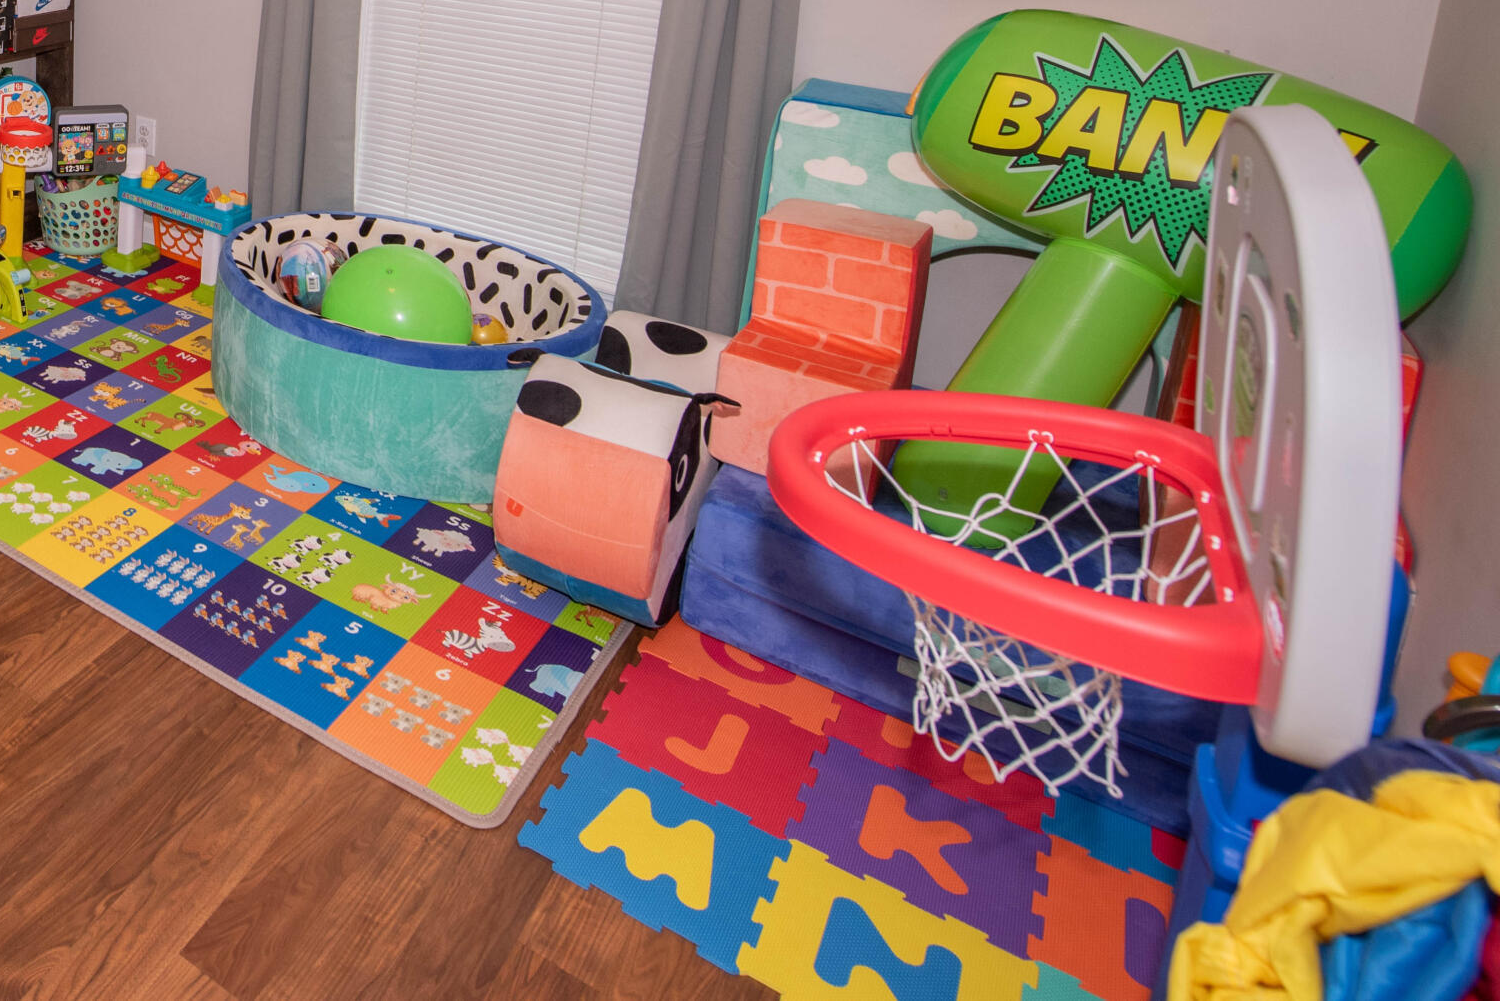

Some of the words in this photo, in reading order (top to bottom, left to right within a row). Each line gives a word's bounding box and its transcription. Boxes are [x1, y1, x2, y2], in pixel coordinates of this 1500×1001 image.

[65, 164, 85, 173] 12:34
[86, 276, 104, 287] Kk
[38, 297, 57, 308] Qq
[83, 314, 100, 325] Rr
[175, 309, 195, 320] Gg
[27, 338, 48, 349] Xx
[123, 331, 150, 344] Mm
[175, 351, 198, 364] Nn
[74, 358, 93, 370] Ss
[127, 379, 144, 391] Tt
[17, 385, 37, 398] Yy
[179, 402, 203, 417] Uu
[66, 409, 88, 423] Zz
[129, 437, 141, 447] 1
[4, 447, 19, 456] 6
[185, 465, 202, 476] 2
[61, 476, 79, 485] 7
[254, 497, 270, 509] 3
[122, 507, 138, 518] 8
[445, 515, 472, 532] Ss
[327, 532, 342, 542] 4
[192, 543, 208, 554] 9
[399, 562, 425, 582] Yy
[261, 578, 288, 597] 10
[481, 601, 514, 622] Zz
[343, 620, 363, 635] 5
[445, 652, 469, 668] Zebra
[435, 668, 452, 682] 6
[664, 713, 750, 775] J
[857, 783, 974, 896] K
[578, 787, 716, 912] M
